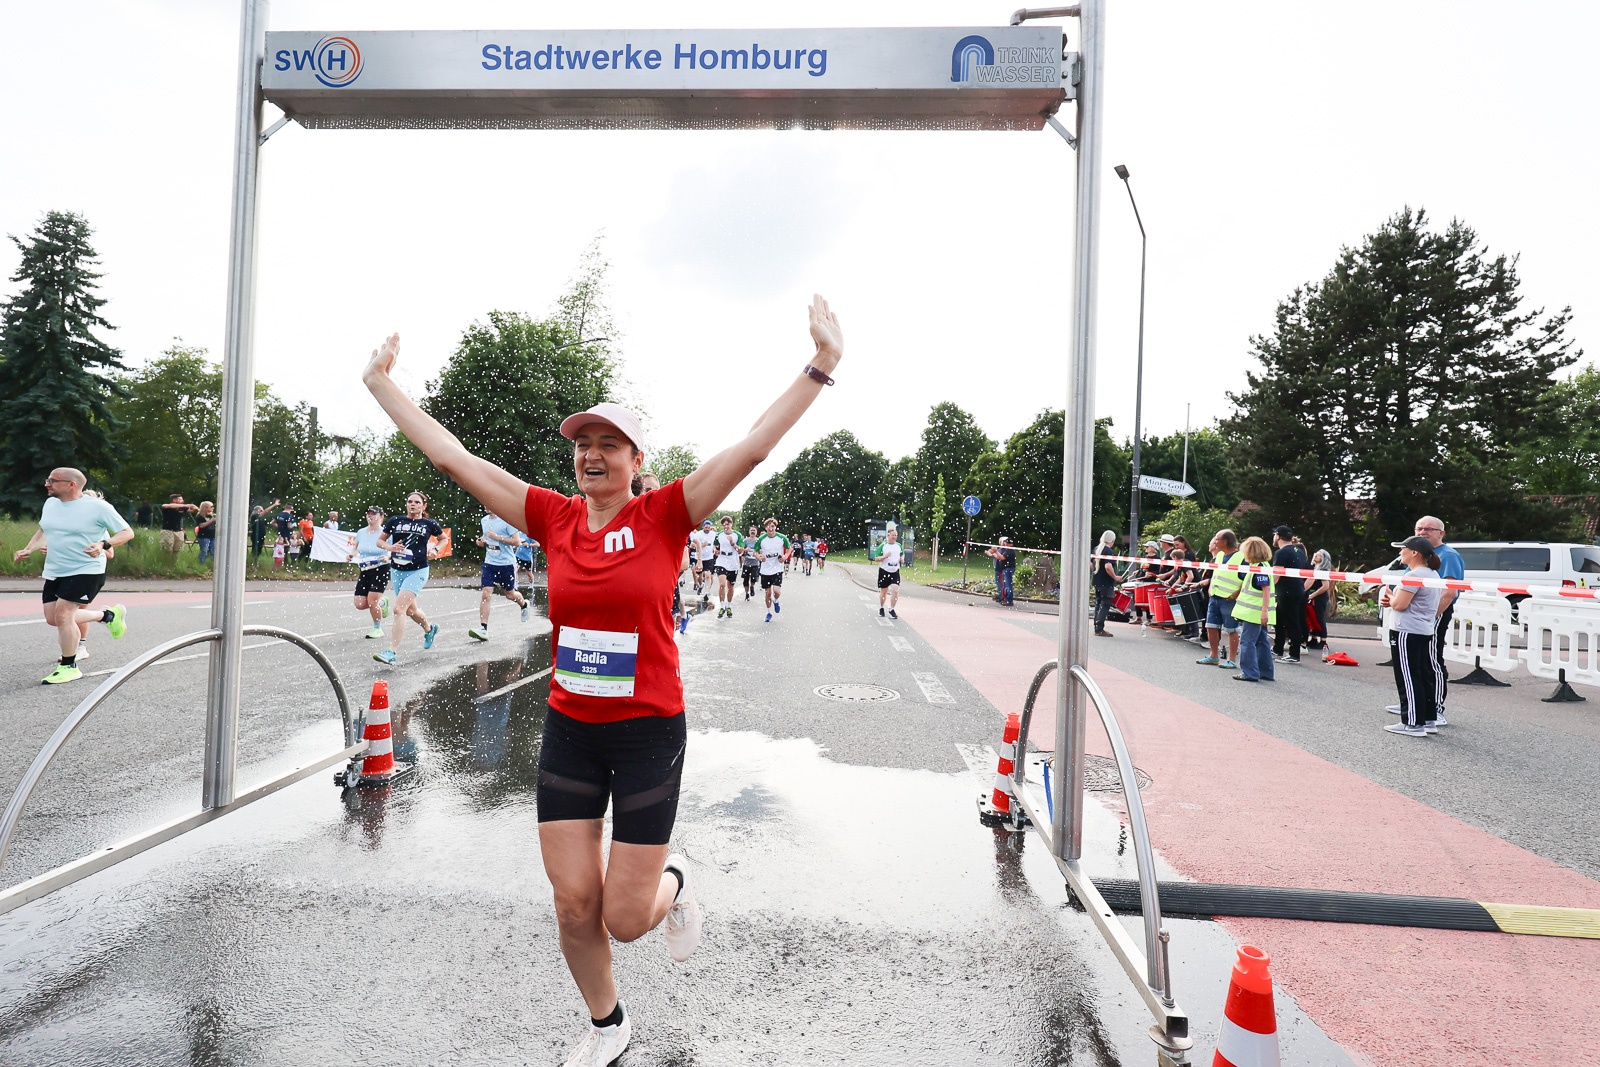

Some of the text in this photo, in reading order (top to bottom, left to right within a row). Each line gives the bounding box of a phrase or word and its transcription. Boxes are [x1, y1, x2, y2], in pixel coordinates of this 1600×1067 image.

[274, 49, 346, 72] SWH
[481, 43, 828, 77] Stadtwerke Homburg
[997, 46, 1055, 64] TRINK
[975, 65, 1056, 83] WASSER
[574, 649, 608, 665] Radia
